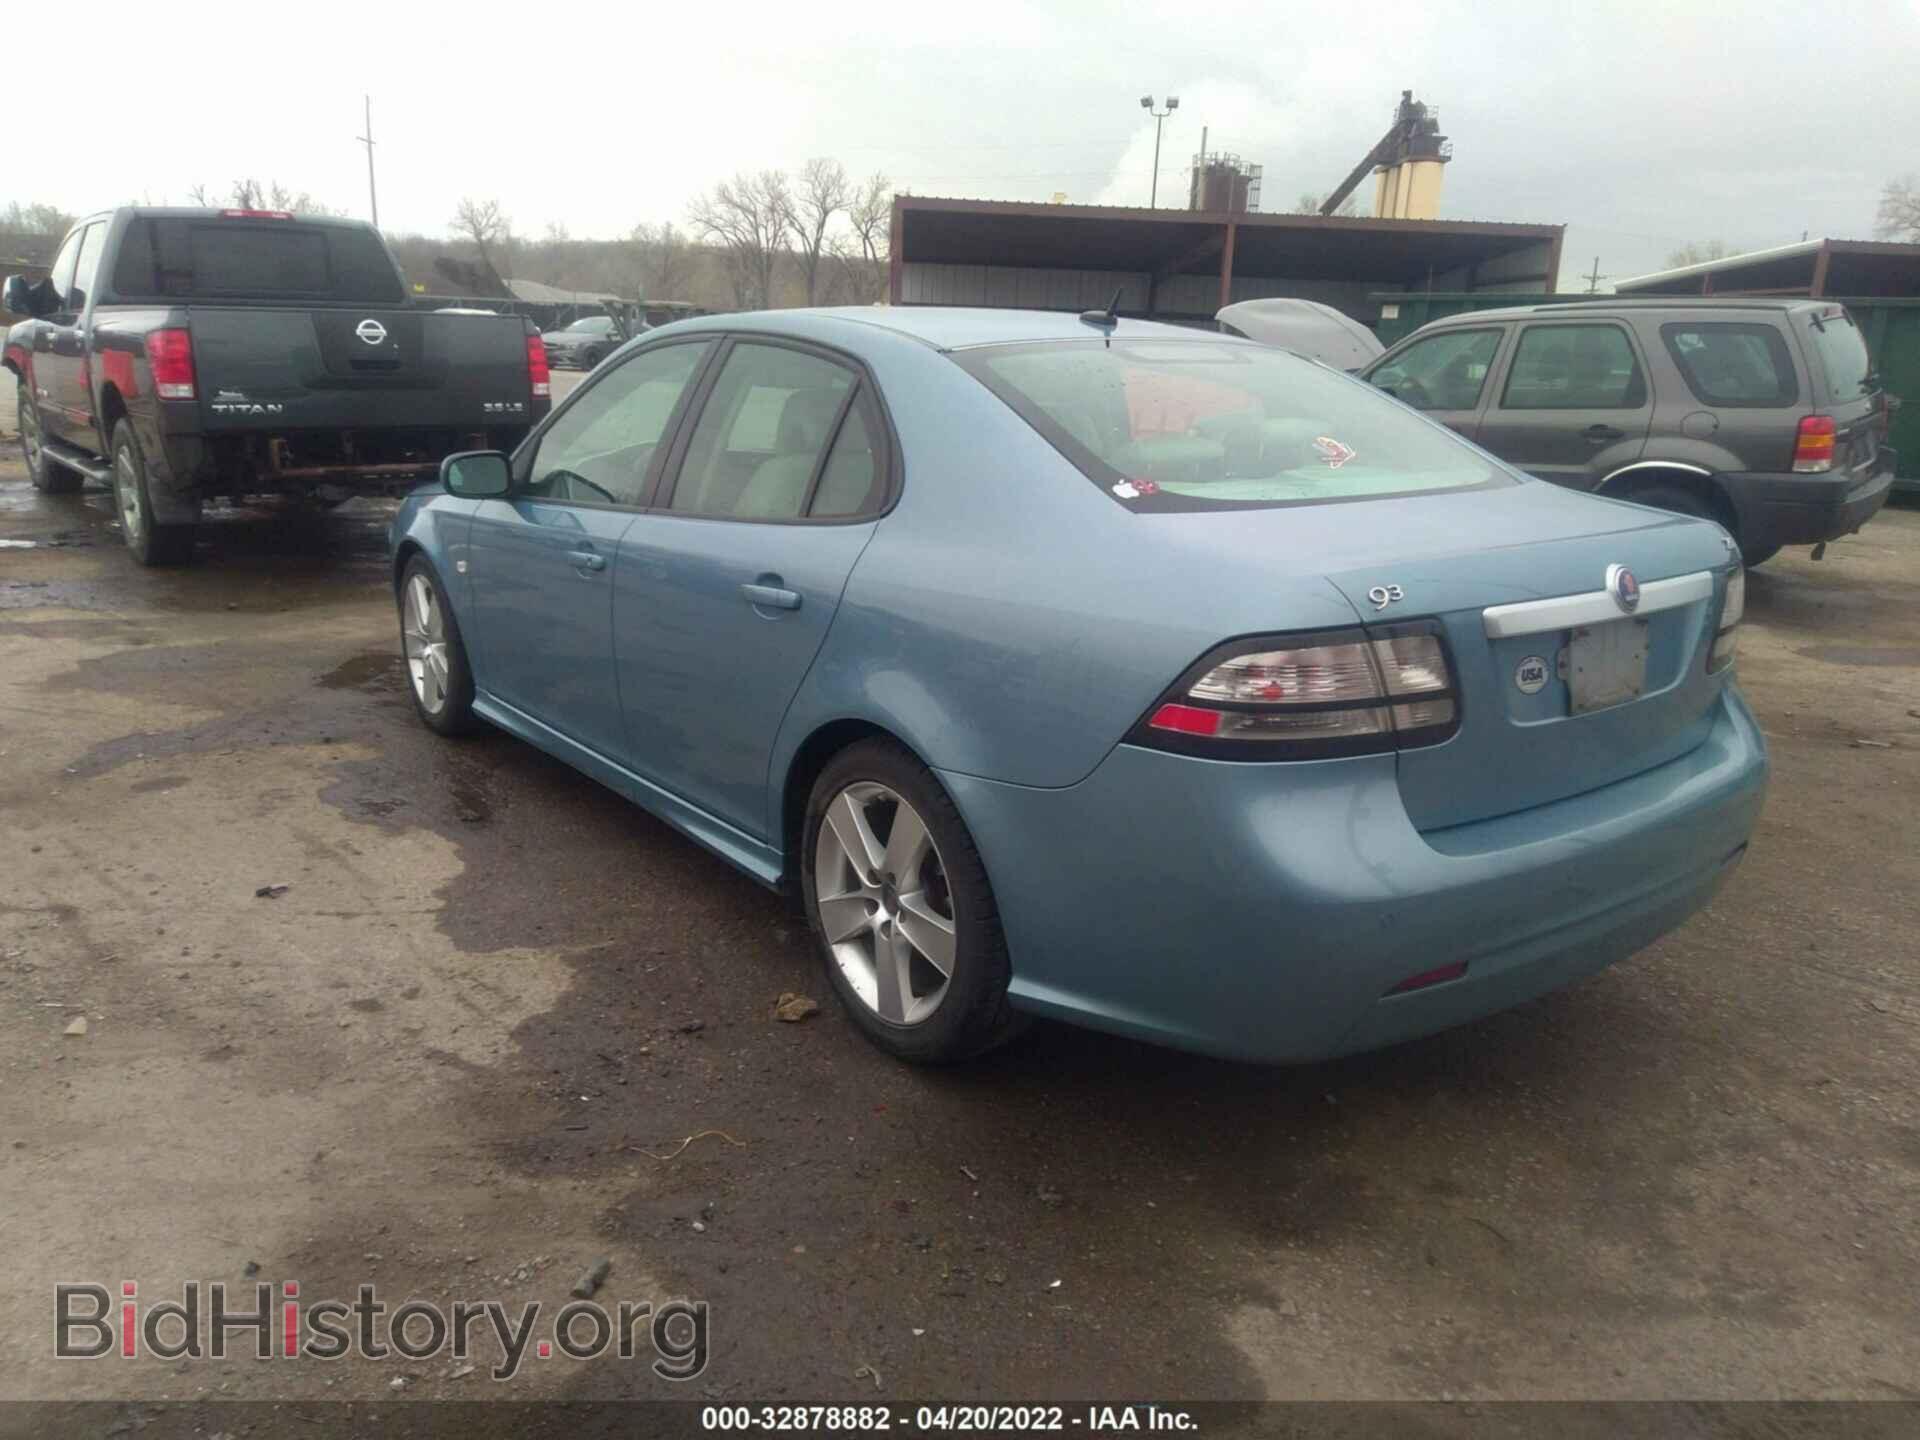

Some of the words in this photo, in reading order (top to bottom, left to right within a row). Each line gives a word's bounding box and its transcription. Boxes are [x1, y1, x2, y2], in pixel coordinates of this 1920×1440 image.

[211, 404, 283, 415] TITAN
[1368, 584, 1405, 611] 93
[1521, 667, 1543, 682] USA
